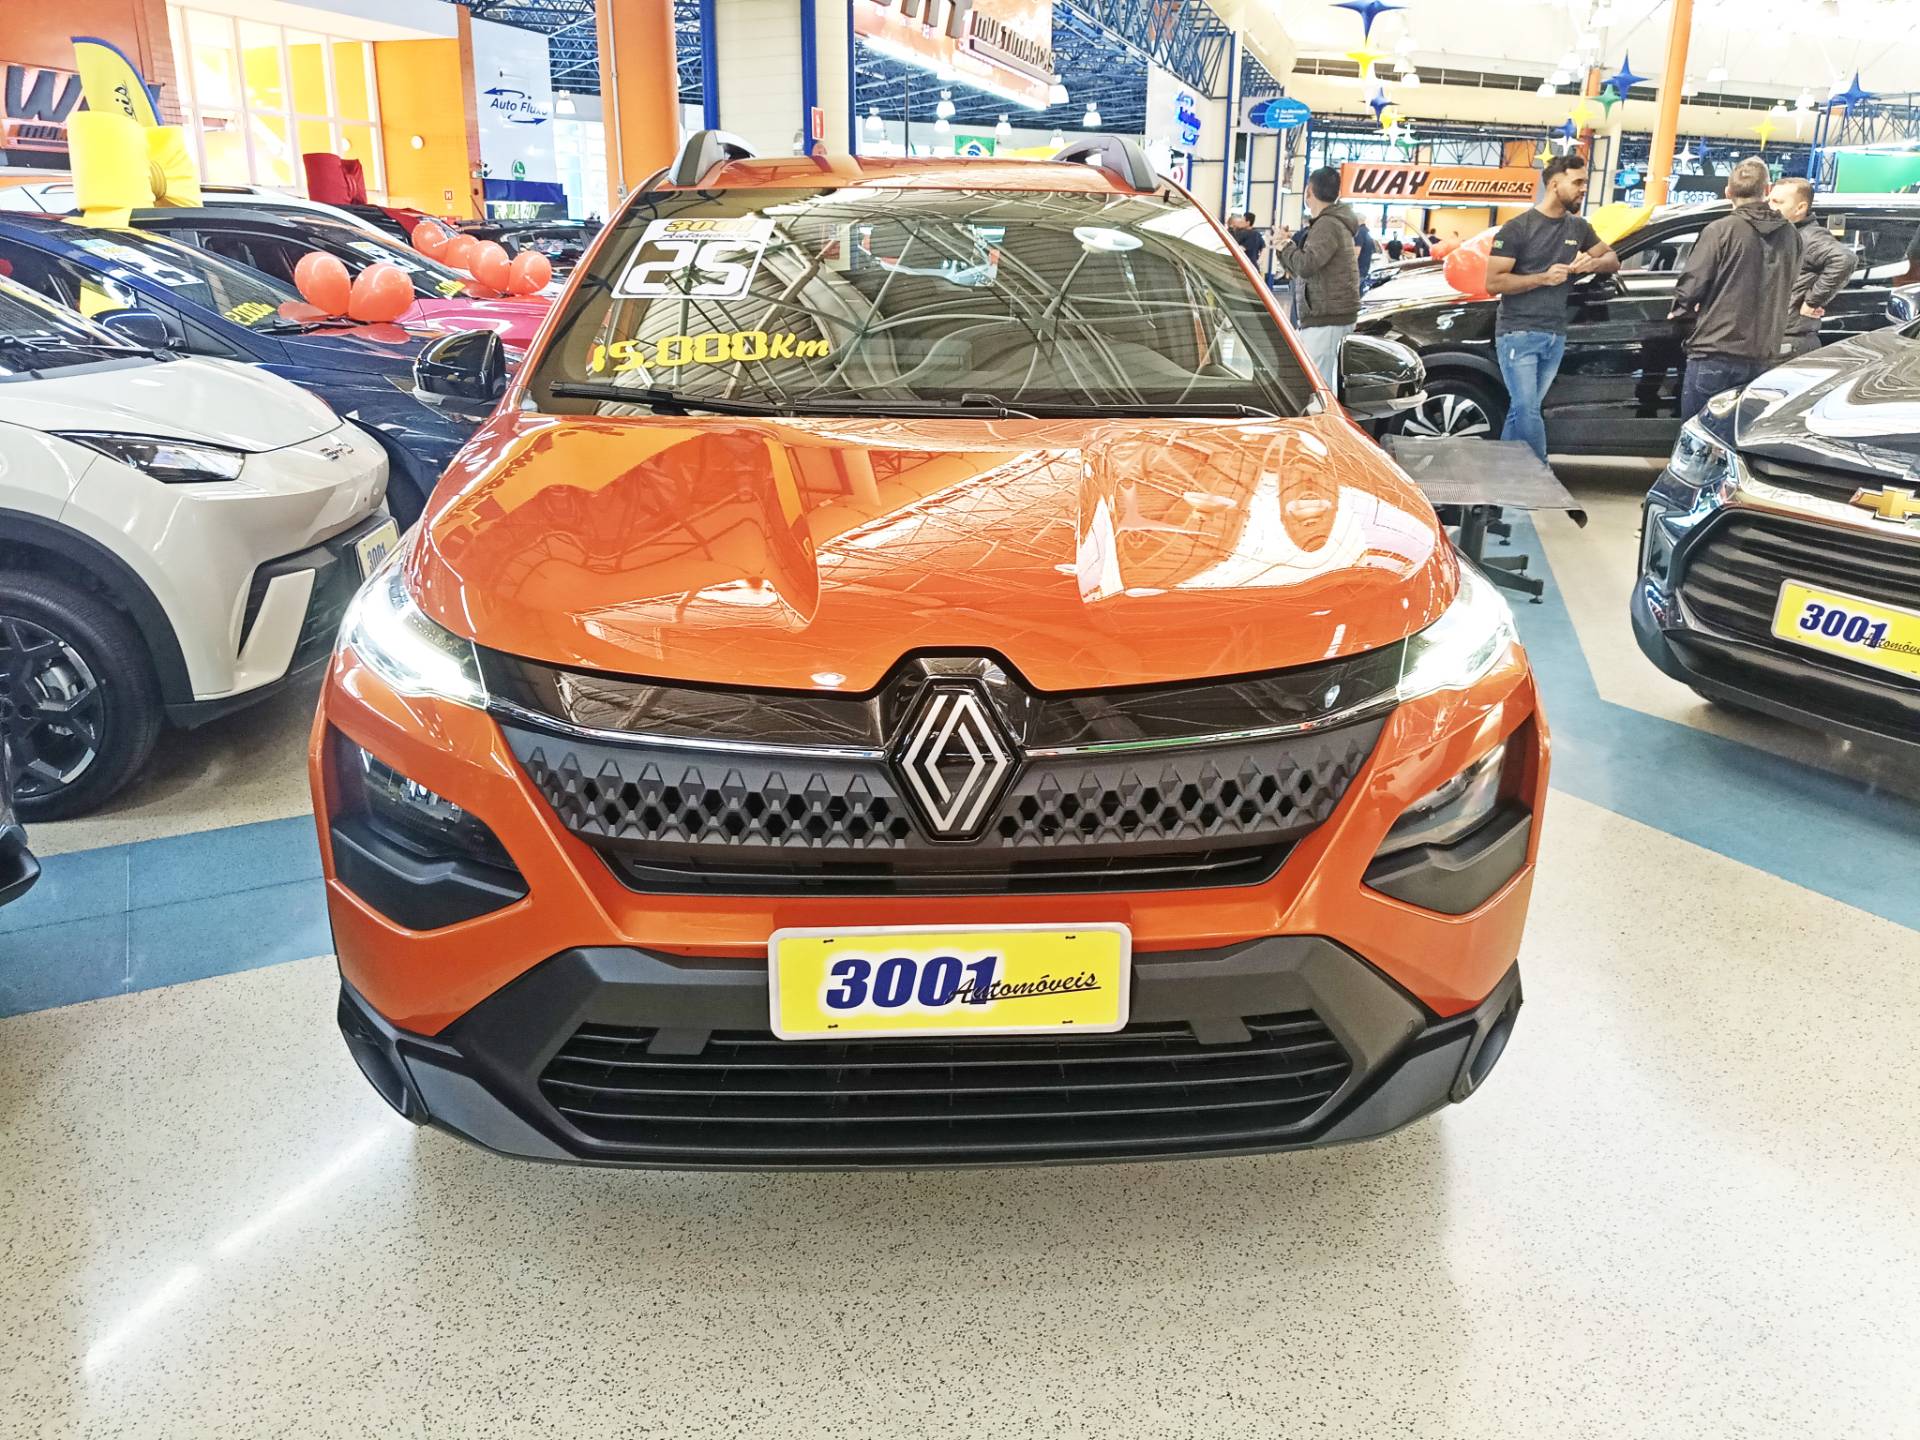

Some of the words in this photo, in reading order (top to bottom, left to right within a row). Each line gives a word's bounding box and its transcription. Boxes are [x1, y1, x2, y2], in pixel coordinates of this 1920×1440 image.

[490, 97, 517, 111] Auto
[1352, 168, 1430, 195] WAY
[1431, 178, 1534, 194] MULTIMARCAS
[664, 219, 758, 232] 3001
[623, 240, 761, 295] 25
[1800, 603, 1887, 648] 3001
[826, 956, 997, 1010] 3001
[944, 971, 1099, 1004] Automóveis
